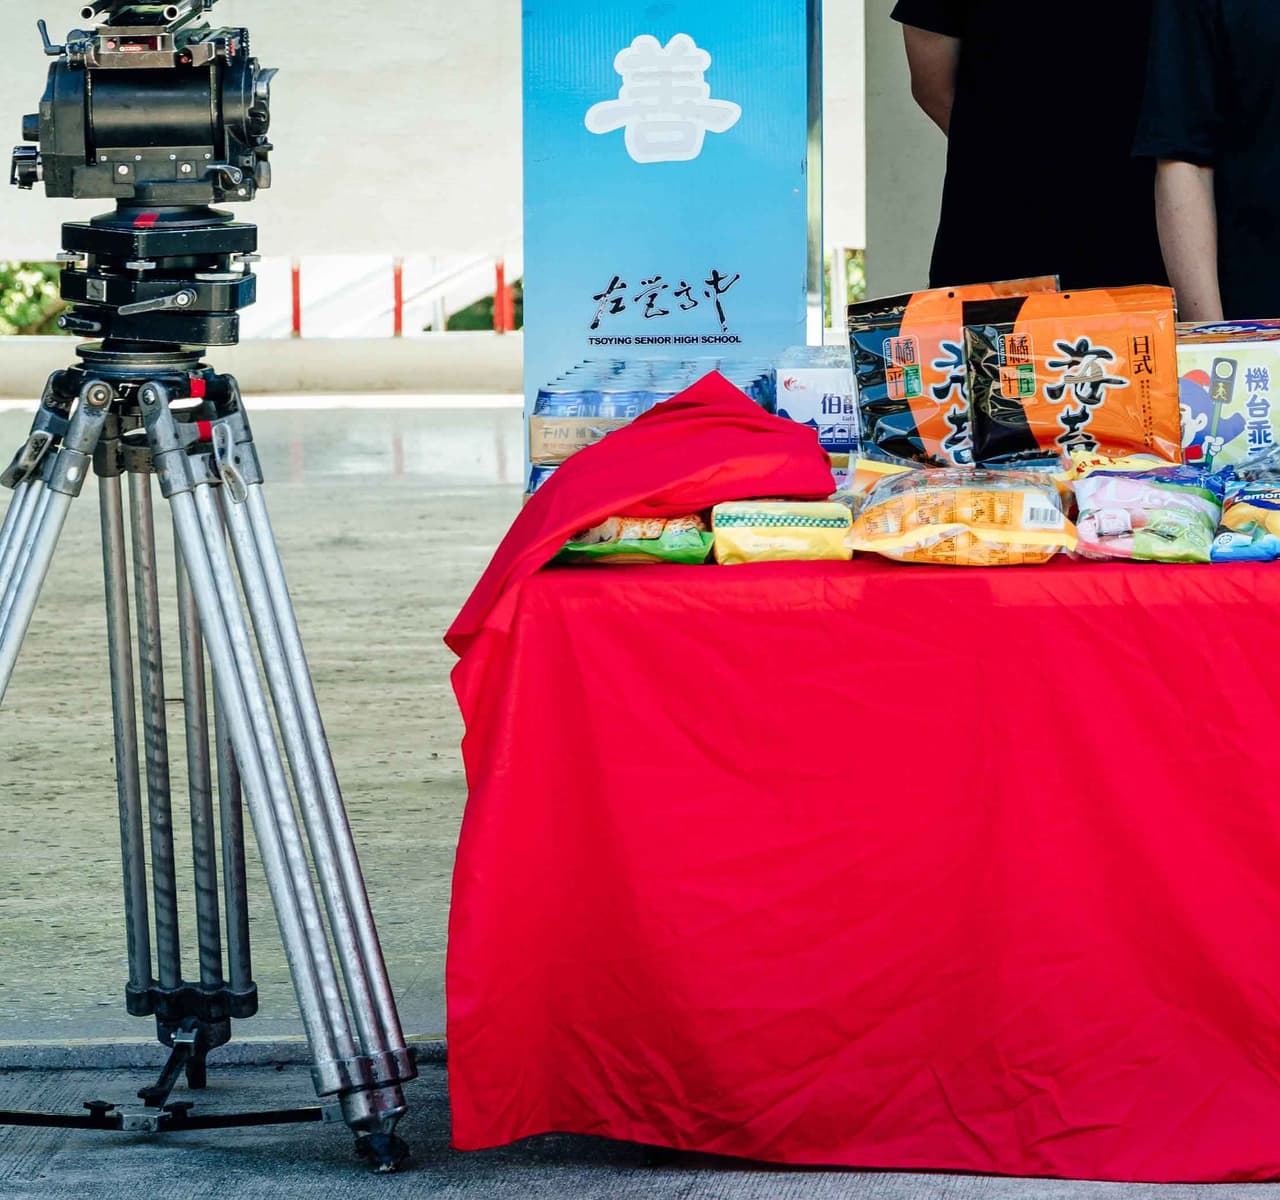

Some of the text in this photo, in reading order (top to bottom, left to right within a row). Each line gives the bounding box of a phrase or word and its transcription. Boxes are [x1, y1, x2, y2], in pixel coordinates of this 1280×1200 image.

[588, 335, 742, 345] TSOYING SENIOR HIGH SCHOOL
[1132, 335, 1153, 375] 日式
[1245, 367, 1272, 456] 機台乖
